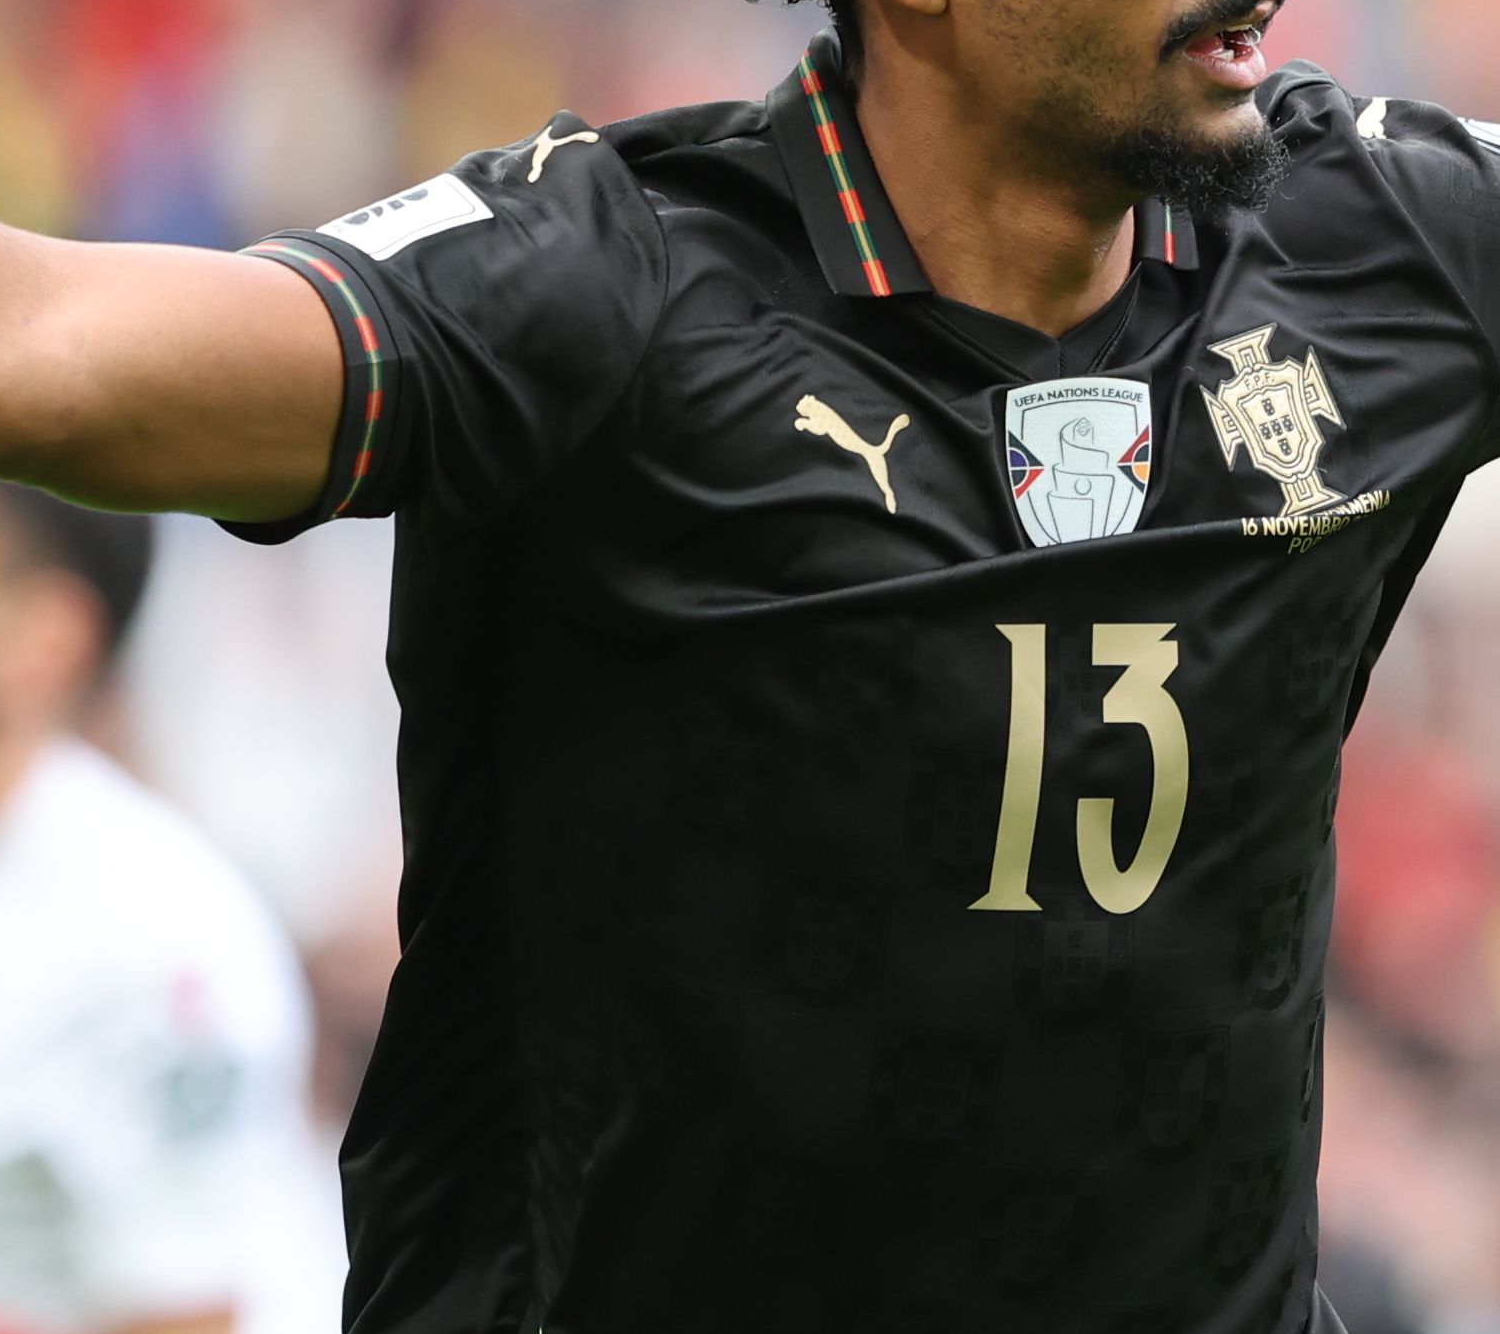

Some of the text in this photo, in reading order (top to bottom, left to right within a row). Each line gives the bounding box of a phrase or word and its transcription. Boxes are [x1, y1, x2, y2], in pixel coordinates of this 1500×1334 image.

[1014, 387, 1143, 407] UEFA NATIONS LEAGUE
[1241, 517, 1258, 536] 16
[967, 623, 1189, 914] 13
